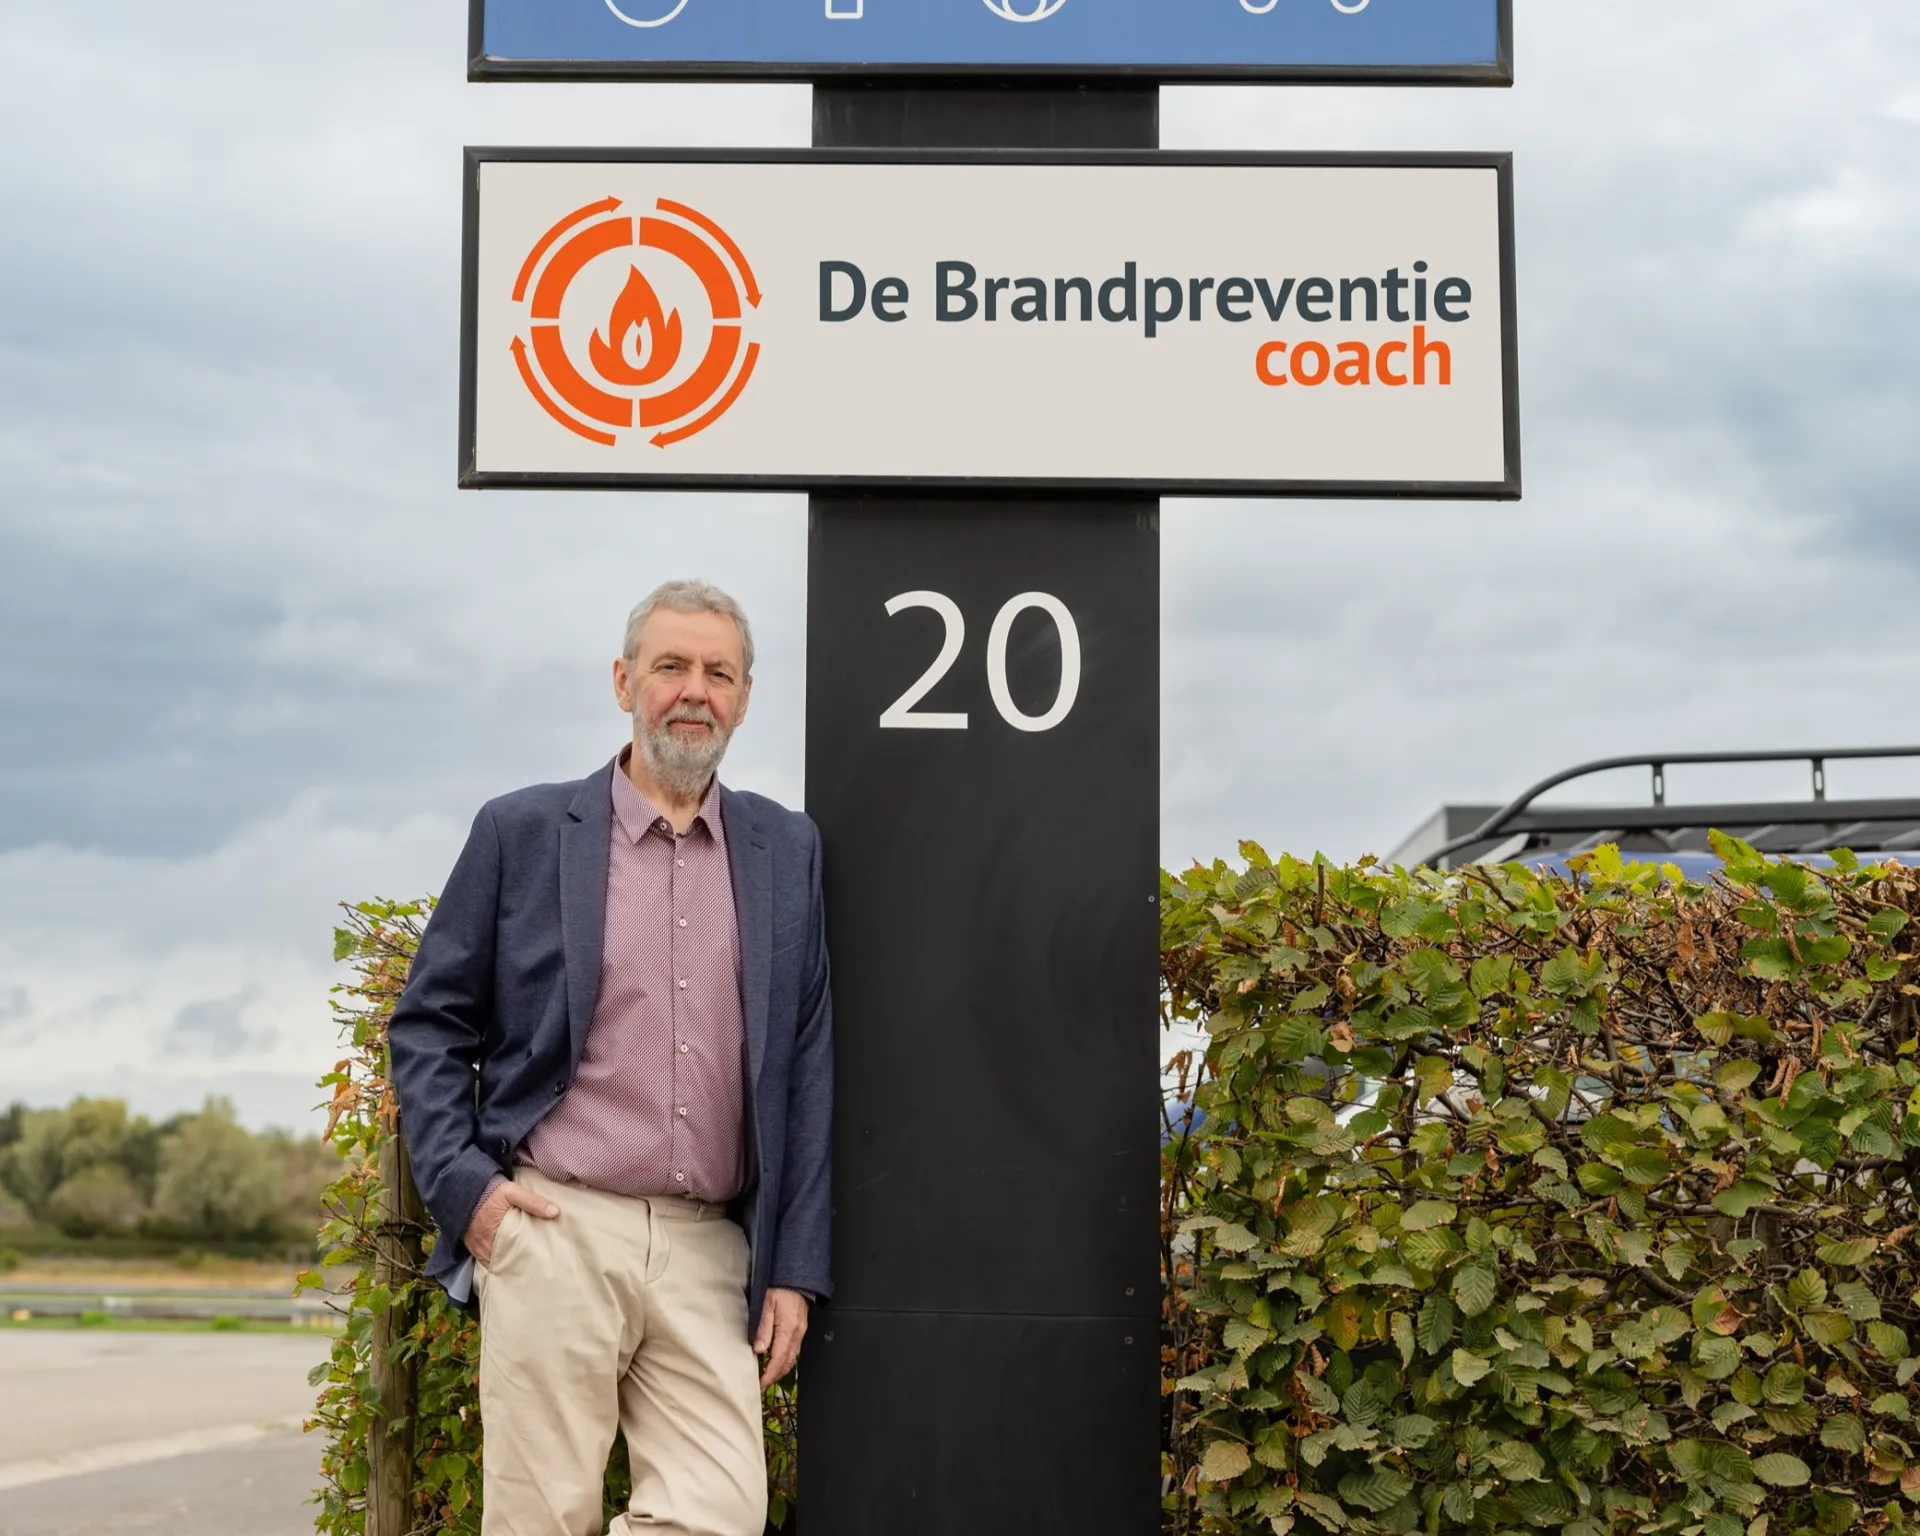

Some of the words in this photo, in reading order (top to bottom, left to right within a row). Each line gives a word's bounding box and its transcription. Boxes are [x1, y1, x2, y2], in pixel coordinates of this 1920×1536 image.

[820, 260, 909, 323] De
[935, 260, 1472, 339] Brandpreventie
[1255, 325, 1451, 386] coach
[879, 590, 1082, 733] 20
